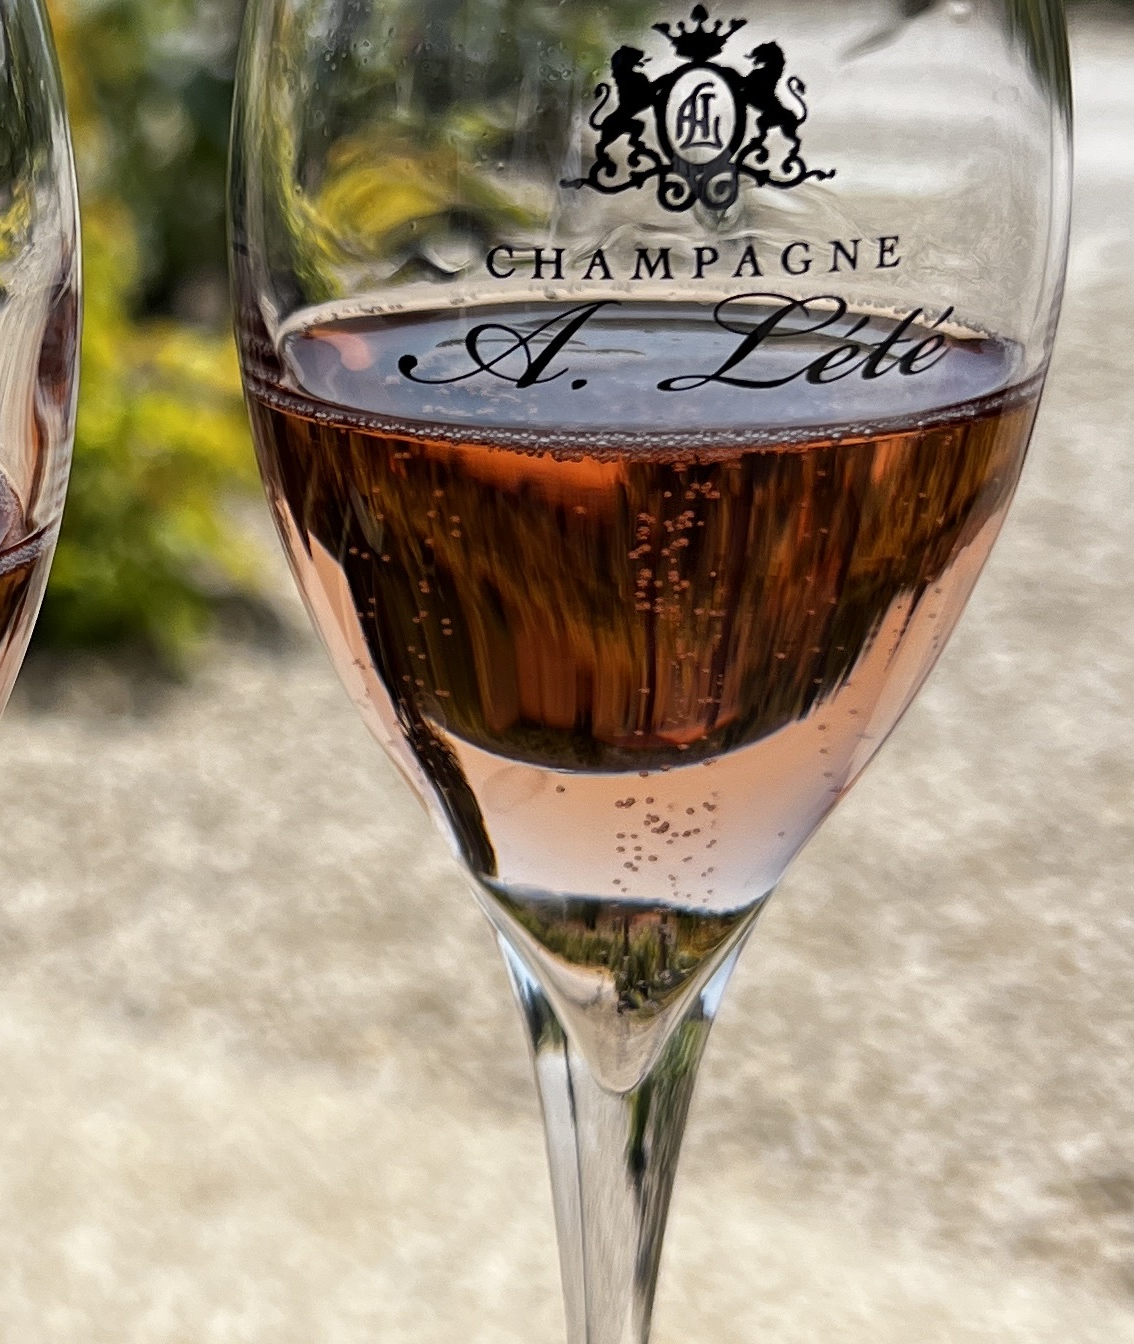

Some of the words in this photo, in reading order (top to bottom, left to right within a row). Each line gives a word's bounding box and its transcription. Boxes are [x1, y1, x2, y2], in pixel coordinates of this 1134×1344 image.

[484, 235, 903, 281] CHAMPAGNE
[397, 300, 622, 391] A.
[656, 292, 955, 393] Lété
